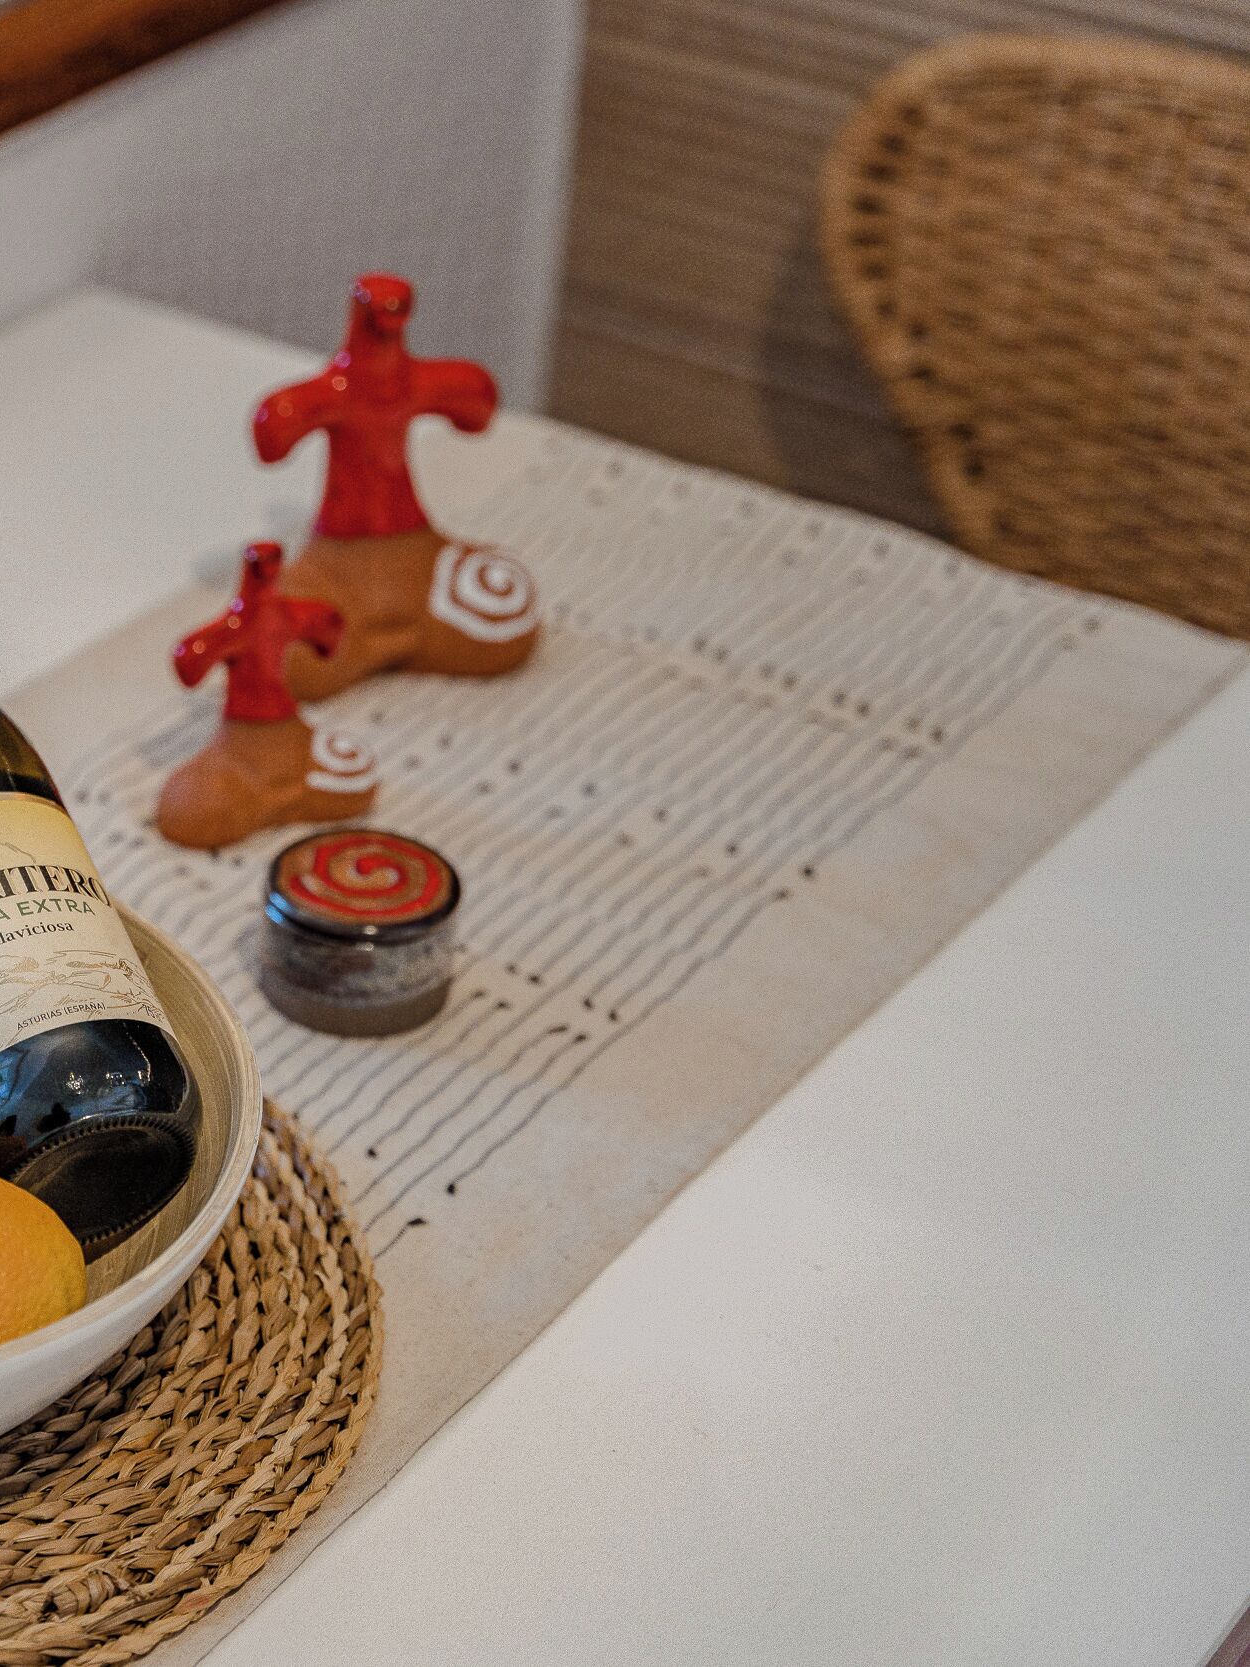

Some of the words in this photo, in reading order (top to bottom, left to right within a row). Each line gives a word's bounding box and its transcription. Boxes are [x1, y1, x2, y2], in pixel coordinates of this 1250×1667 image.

[16, 898, 96, 916] EXTRA
[16, 1008, 63, 1031] ASTURIAS
[63, 1001, 107, 1016] (ESPAÑA)
